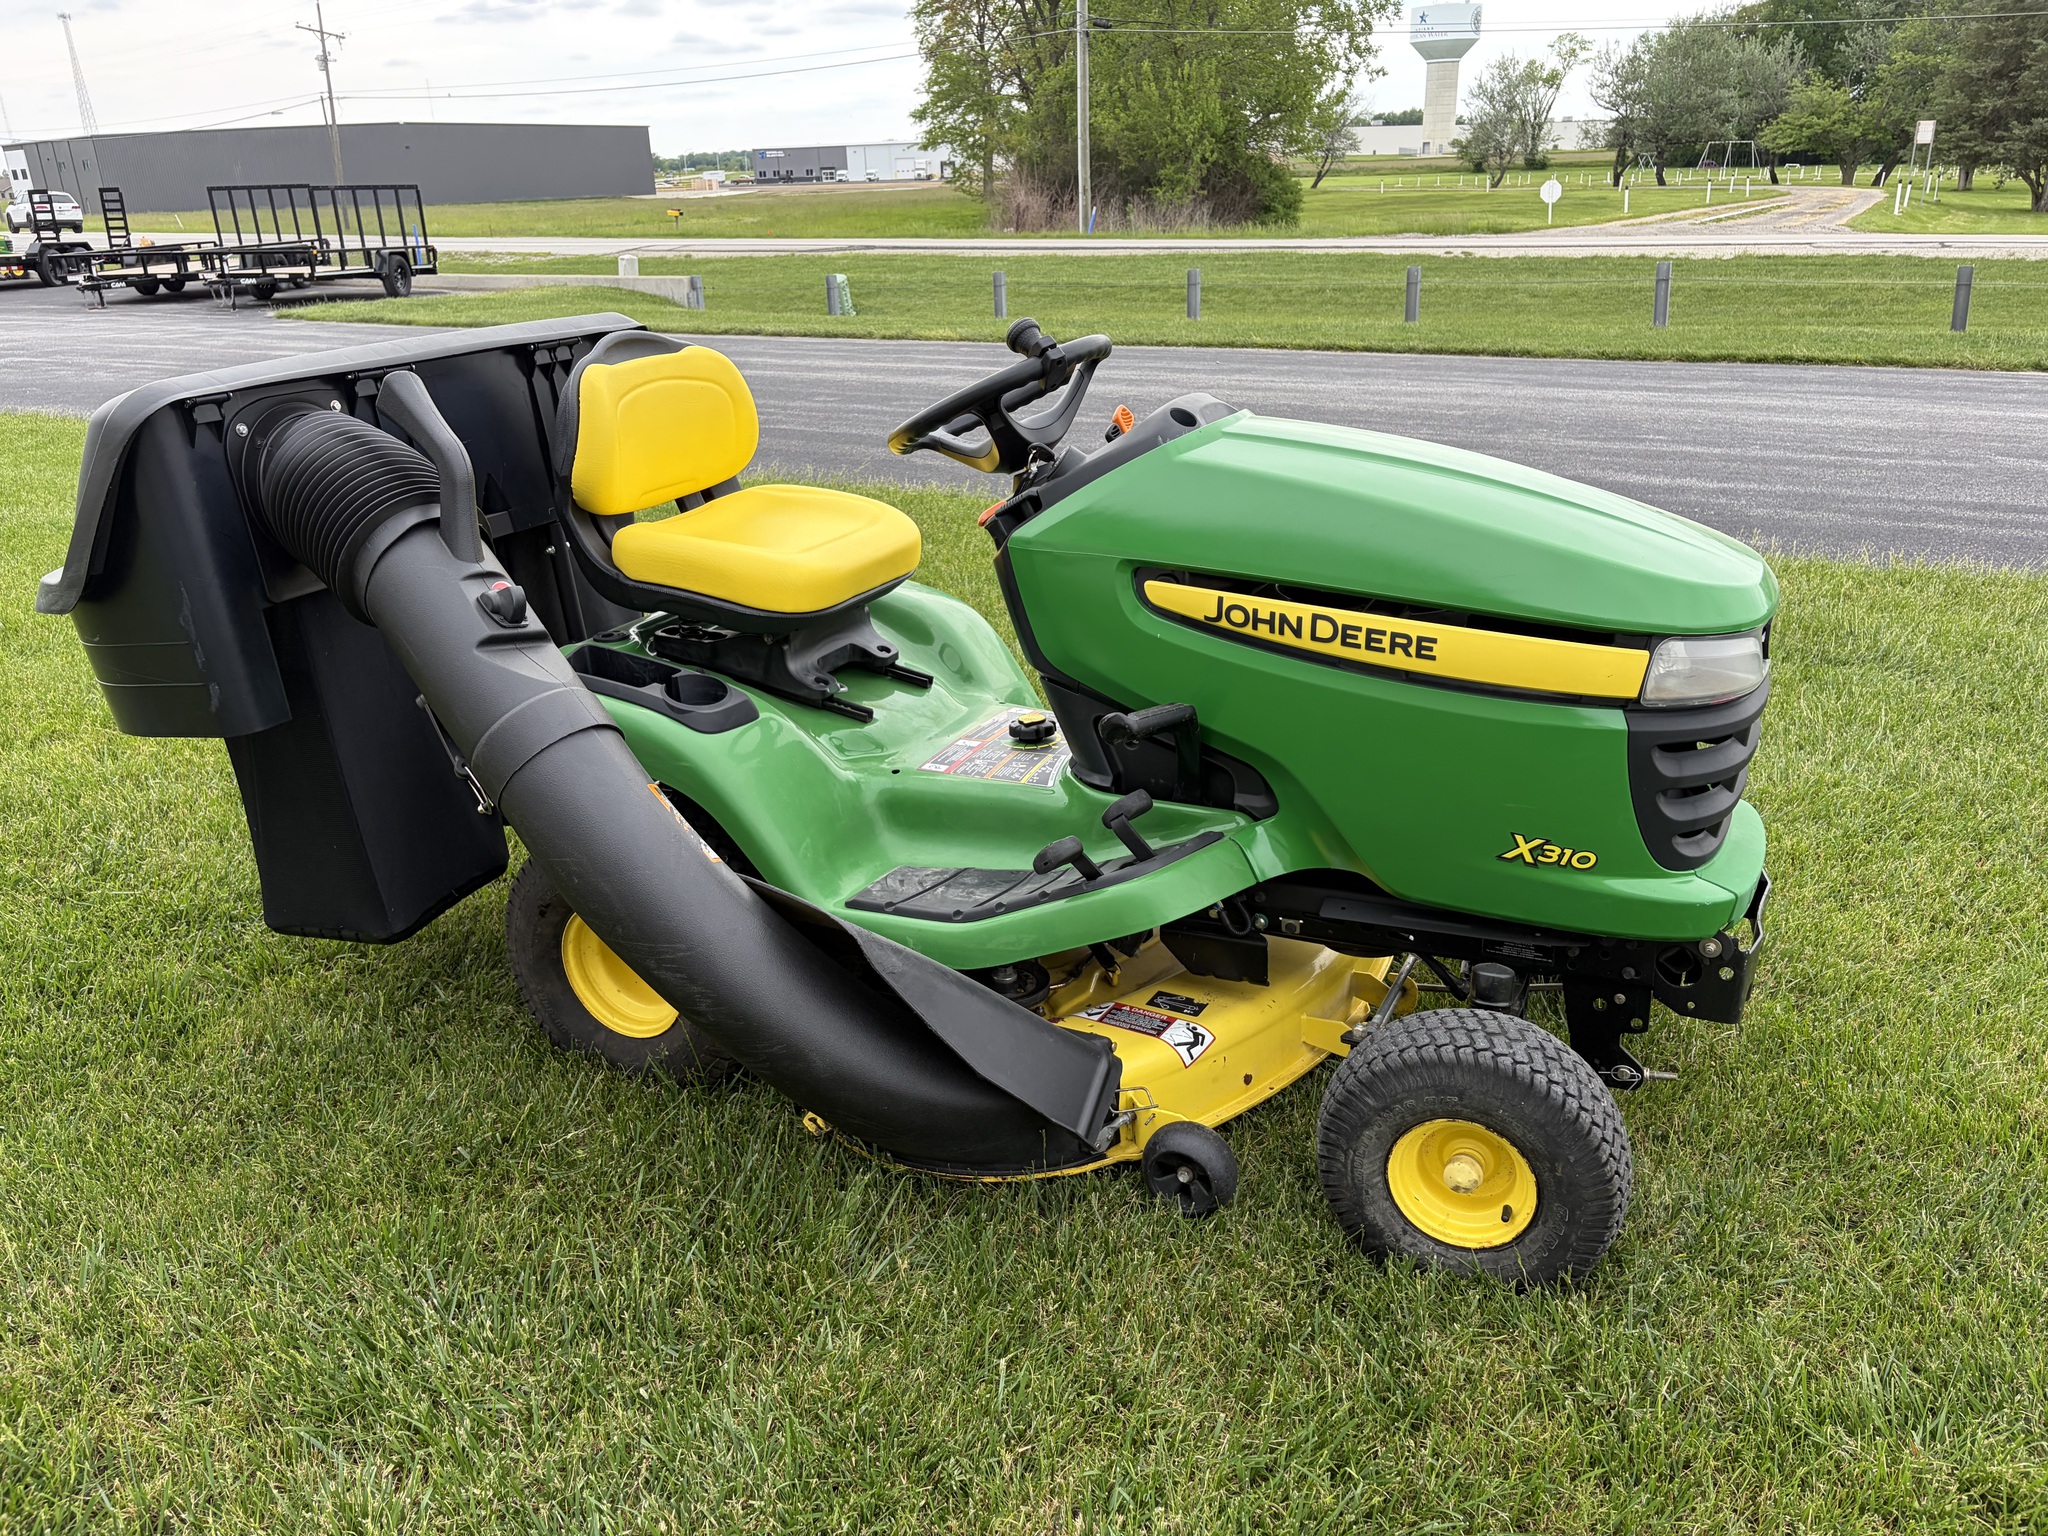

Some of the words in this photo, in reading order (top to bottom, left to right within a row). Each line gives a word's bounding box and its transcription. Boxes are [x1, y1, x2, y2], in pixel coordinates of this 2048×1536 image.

[1203, 595, 1304, 639] JOHN
[1310, 613, 1438, 661] DEERE
[1496, 832, 1598, 870] X310
[1131, 1007, 1168, 1020] DANGER
